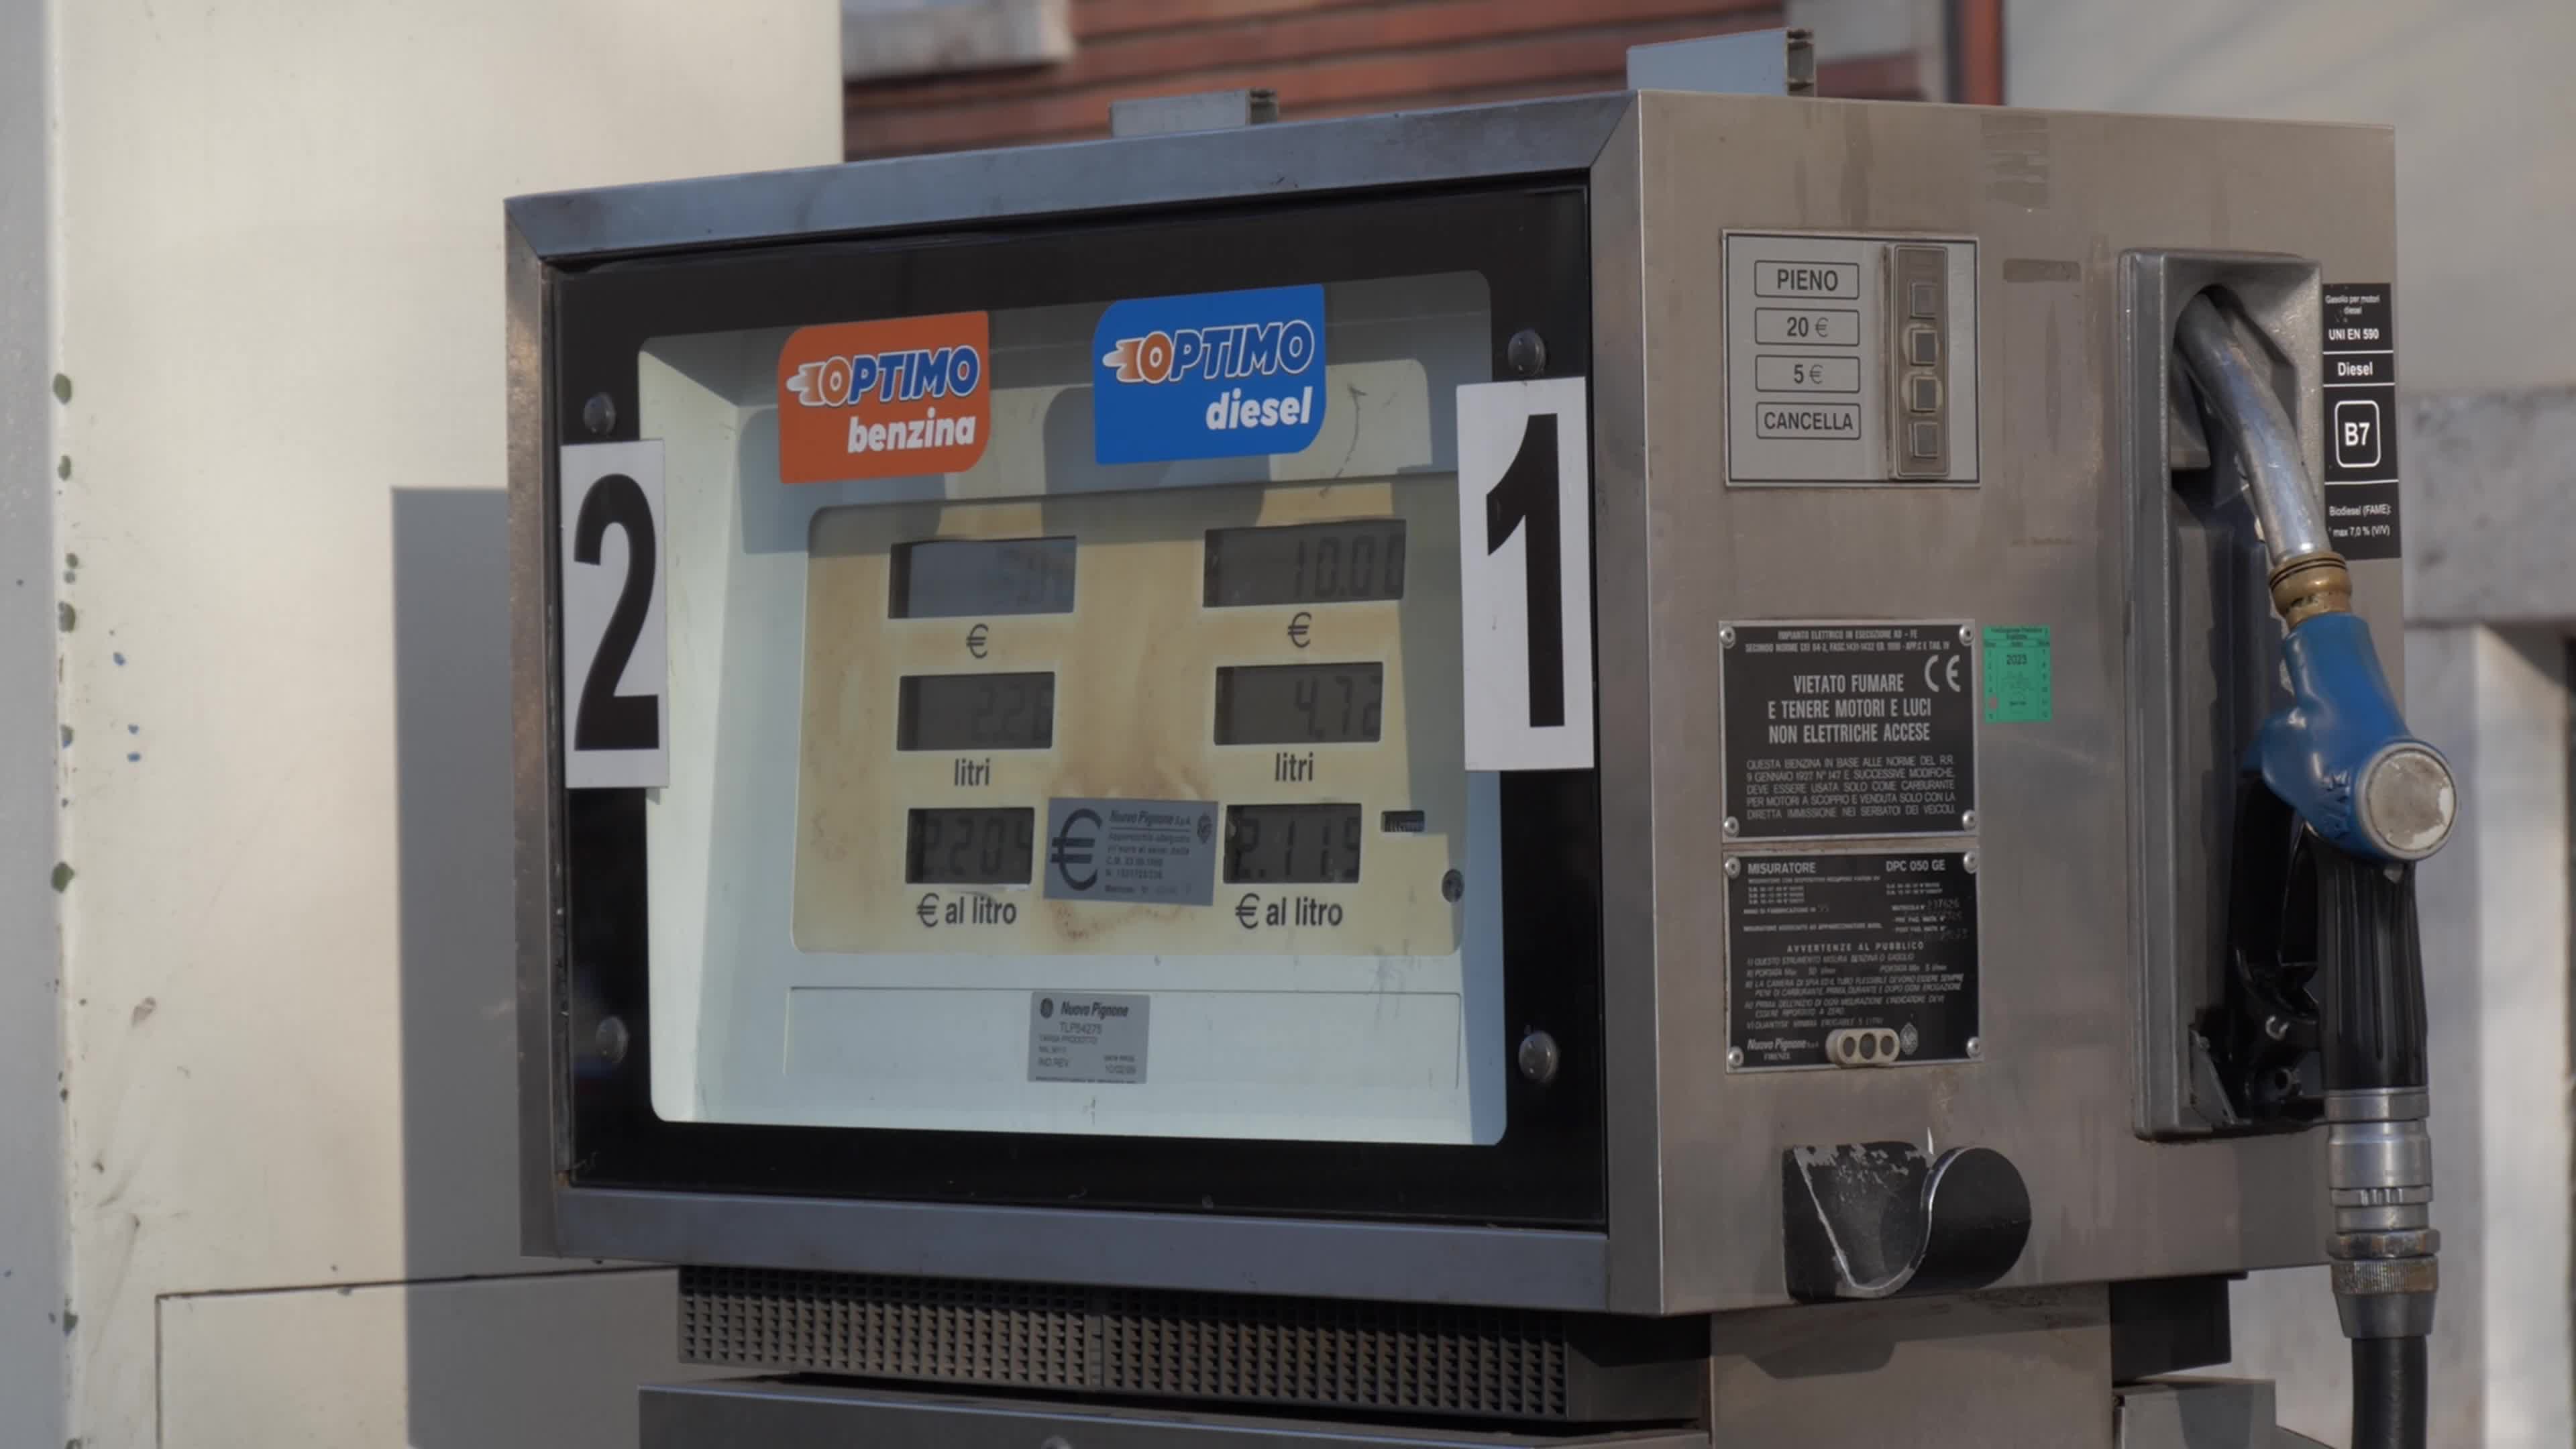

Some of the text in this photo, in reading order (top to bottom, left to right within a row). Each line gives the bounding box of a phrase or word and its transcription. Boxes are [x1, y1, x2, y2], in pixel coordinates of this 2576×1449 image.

[1777, 269, 1838, 291] PIENO
[1786, 317, 1829, 337] 20 €
[2328, 328, 2379, 340] UNI EN 590
[1129, 319, 1316, 384] OPTIMO
[813, 345, 981, 407] OPTIMO
[1793, 364, 1824, 384] 5 €
[2337, 361, 2373, 376] Diesel
[1206, 386, 1313, 430] diesel
[848, 408, 975, 454] benzina
[1764, 412, 1853, 430] CANCELLA
[2345, 422, 2370, 446] B7
[1487, 413, 1561, 727] 1
[574, 474, 660, 751] 2
[1288, 612, 1311, 648] €
[966, 623, 989, 659] €
[2006, 654, 2027, 665] 2023
[1793, 674, 1904, 694] VIETATO FUMARE
[1768, 698, 1931, 719] E TENERE MOTORI E LUCI
[1769, 722, 1930, 744] NON ELETTRICHE ACCESE
[954, 758, 990, 786] litri
[1275, 752, 1313, 782] litri
[1746, 759, 1781, 770] QUESTA
[1784, 759, 1821, 769] BENZINA
[1824, 758, 1833, 768] IN
[1835, 757, 1860, 768] BASE
[1862, 756, 1882, 767] ALLE
[1886, 756, 1916, 767] NORME
[1920, 755, 1935, 765] DEL
[1754, 771, 1793, 782] GENNAIO
[1844, 769, 1850, 780] E
[1853, 768, 1906, 779] SUCCESSIVE
[1746, 780, 1954, 794] DEVE ESSERE USATA SOLO COME CARBURANTE
[1746, 792, 1955, 807] PER MOTORI A SCOPPIO E VENDUTA SOLO CON LA
[1746, 809, 1782, 820] DIRETTA
[1786, 808, 1837, 818] IMMISSIONE
[1841, 807, 1856, 817] NEI
[1860, 806, 1900, 816] SERBATOI
[1905, 804, 1919, 815] DEI
[1050, 808, 1103, 891] €
[1748, 862, 1816, 874] MISURATORE
[1886, 859, 1946, 871] DPC 050 GE
[917, 893, 1017, 928] € al litro
[1236, 893, 1343, 929] € al litro
[1787, 941, 1925, 953] AVVERTENZE AL PUBBLICO
[1061, 1001, 1129, 1020] Nuovo Pignone
[1748, 1038, 1806, 1051] Nuovo Pignone
